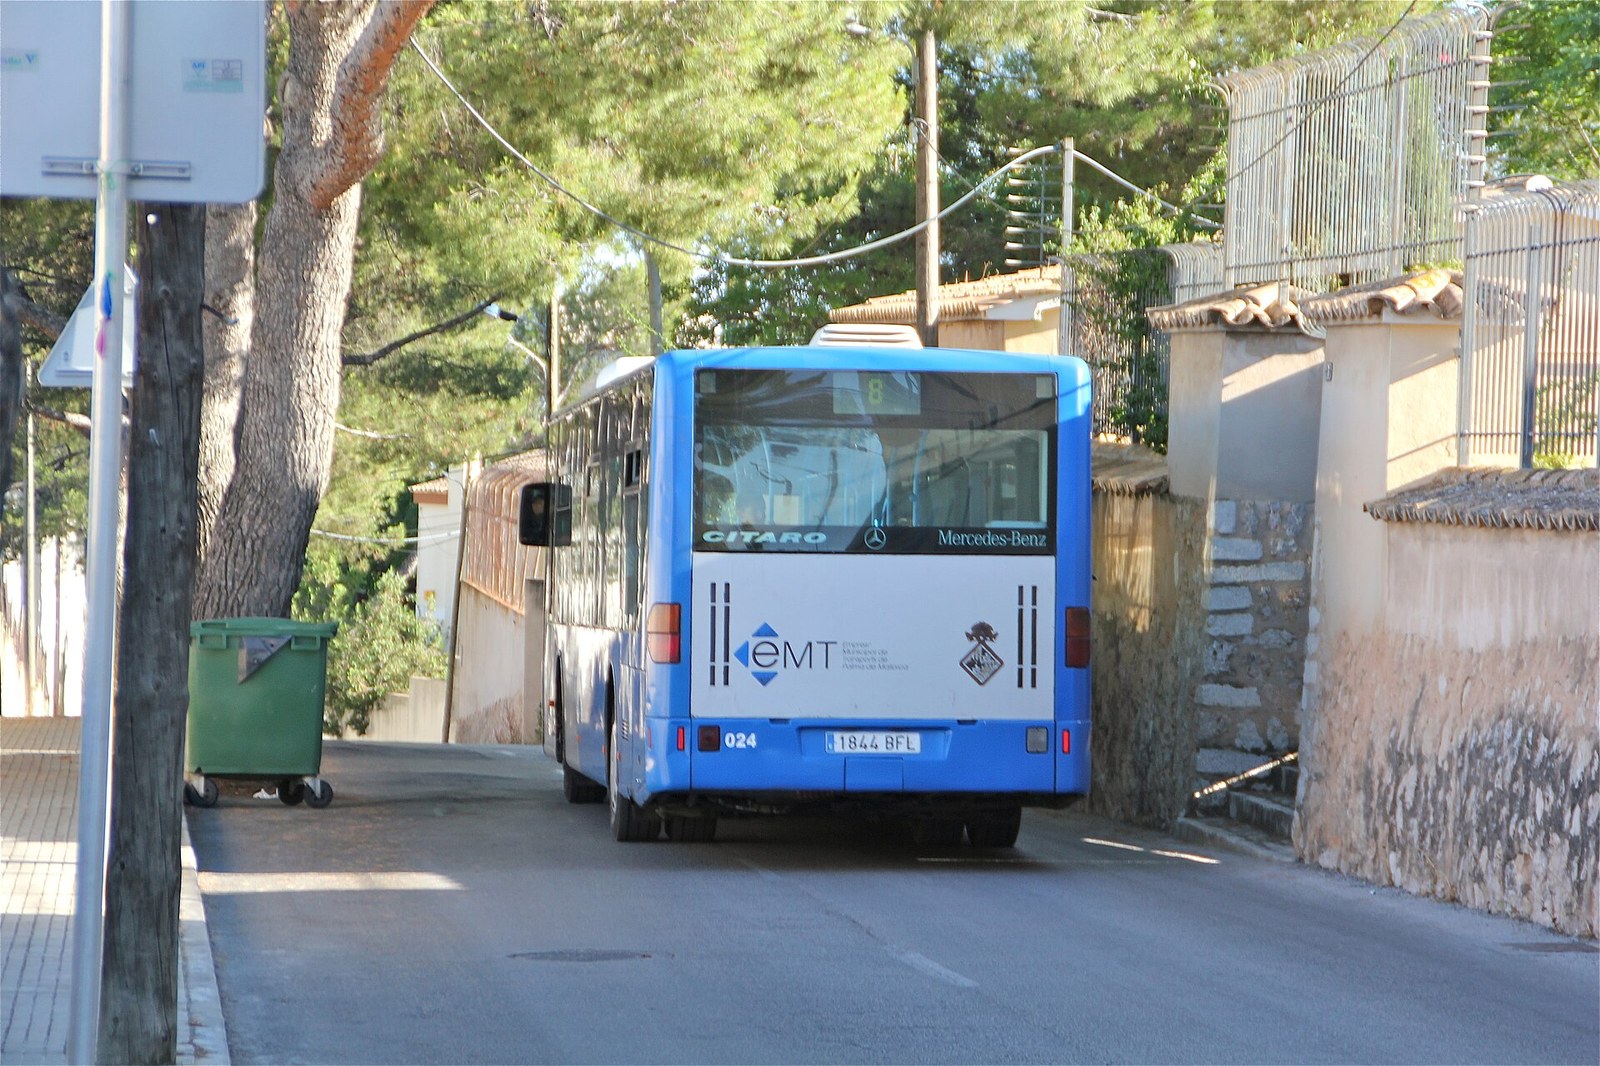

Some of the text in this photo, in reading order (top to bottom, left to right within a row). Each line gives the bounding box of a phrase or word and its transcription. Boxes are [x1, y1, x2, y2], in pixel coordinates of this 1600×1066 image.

[869, 379, 883, 405] 8
[702, 531, 827, 543] CITARO
[938, 529, 1047, 546] Mercedes-Benz
[725, 732, 756, 748] 024
[840, 735, 916, 751] 1844 BFL
